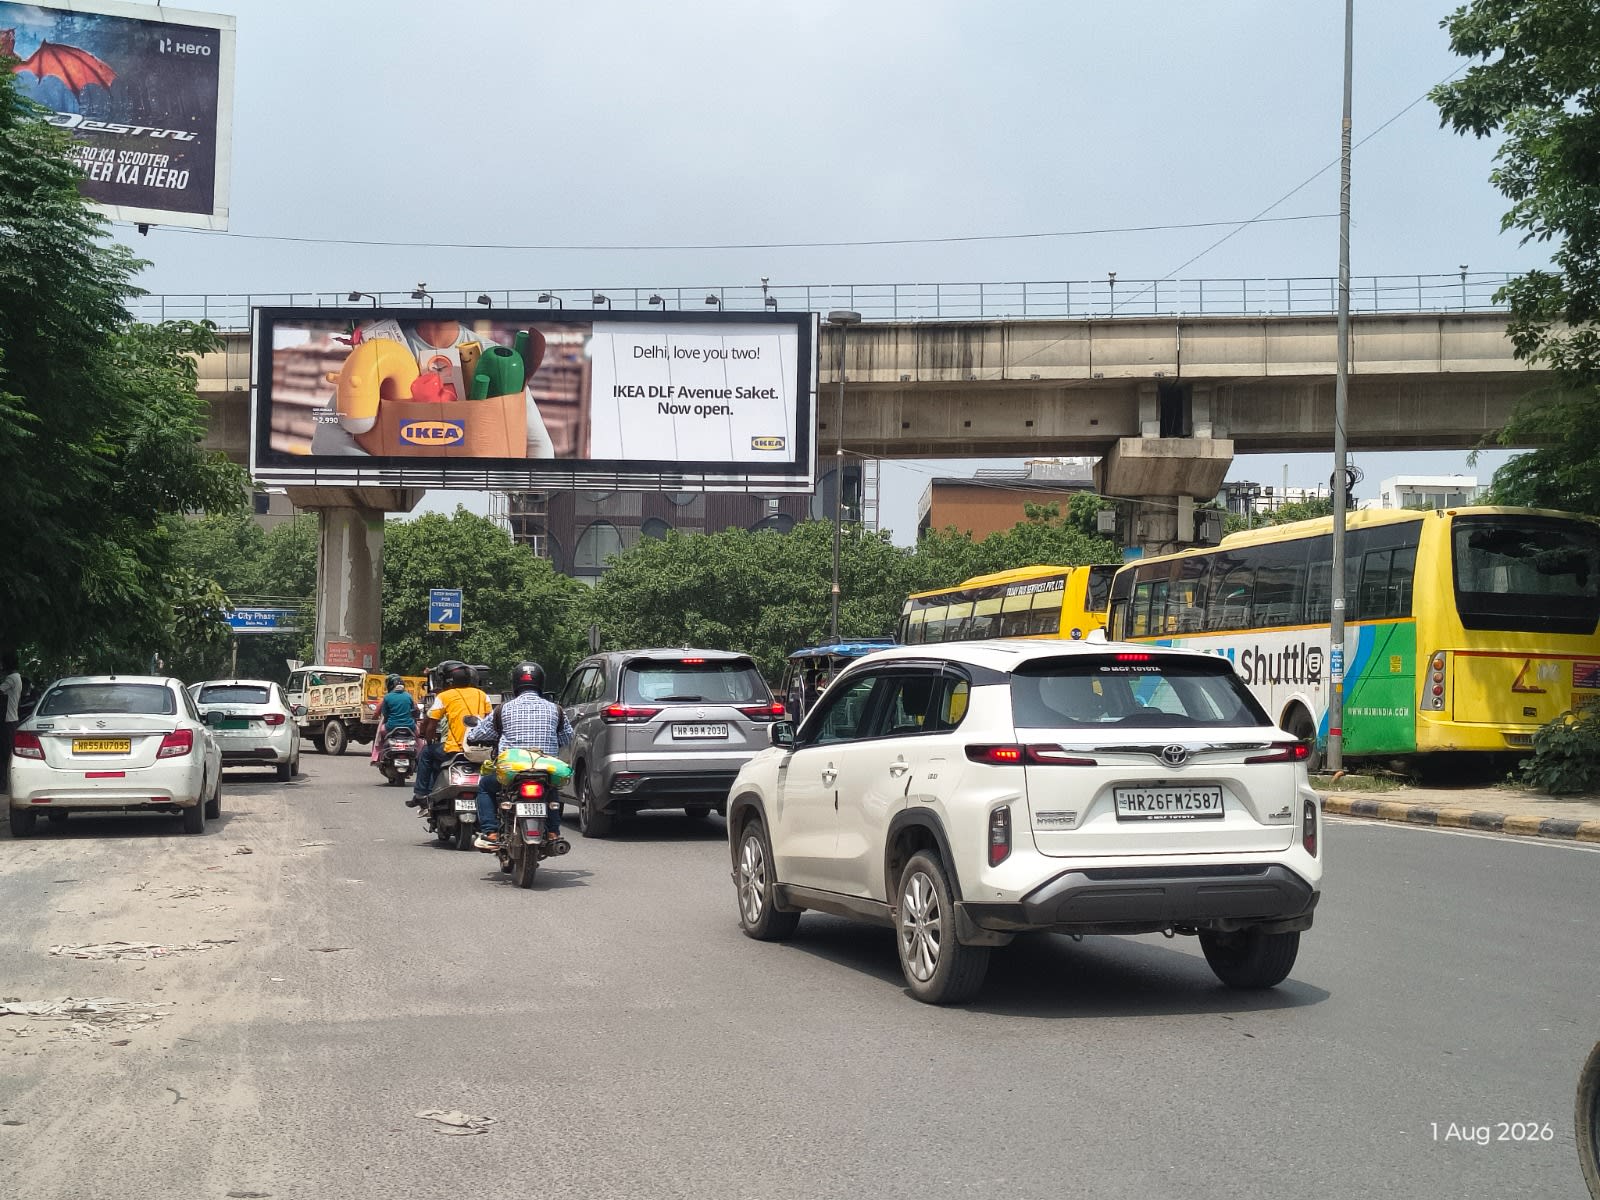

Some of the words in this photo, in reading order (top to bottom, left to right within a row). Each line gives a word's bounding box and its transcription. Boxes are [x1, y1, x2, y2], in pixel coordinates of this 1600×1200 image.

[176, 42, 211, 56] Hero
[98, 148, 115, 163] KA
[117, 150, 170, 168] SCOOTER
[115, 163, 141, 185] KA
[143, 166, 190, 190] HERO
[633, 345, 670, 361] Delhi,
[673, 345, 700, 359] love
[703, 349, 728, 363] you
[731, 347, 760, 359] two!
[613, 385, 646, 398] IKEA
[648, 385, 675, 398] DLF
[677, 386, 732, 399] Avenue
[735, 386, 779, 399] Saket.
[657, 402, 692, 415] Now
[694, 404, 734, 418] open.
[406, 427, 460, 439] IKEA
[707, 726, 727, 735] 2030
[78, 741, 129, 750] HR55AU7095
[1127, 793, 1220, 810] HR26FM2587
